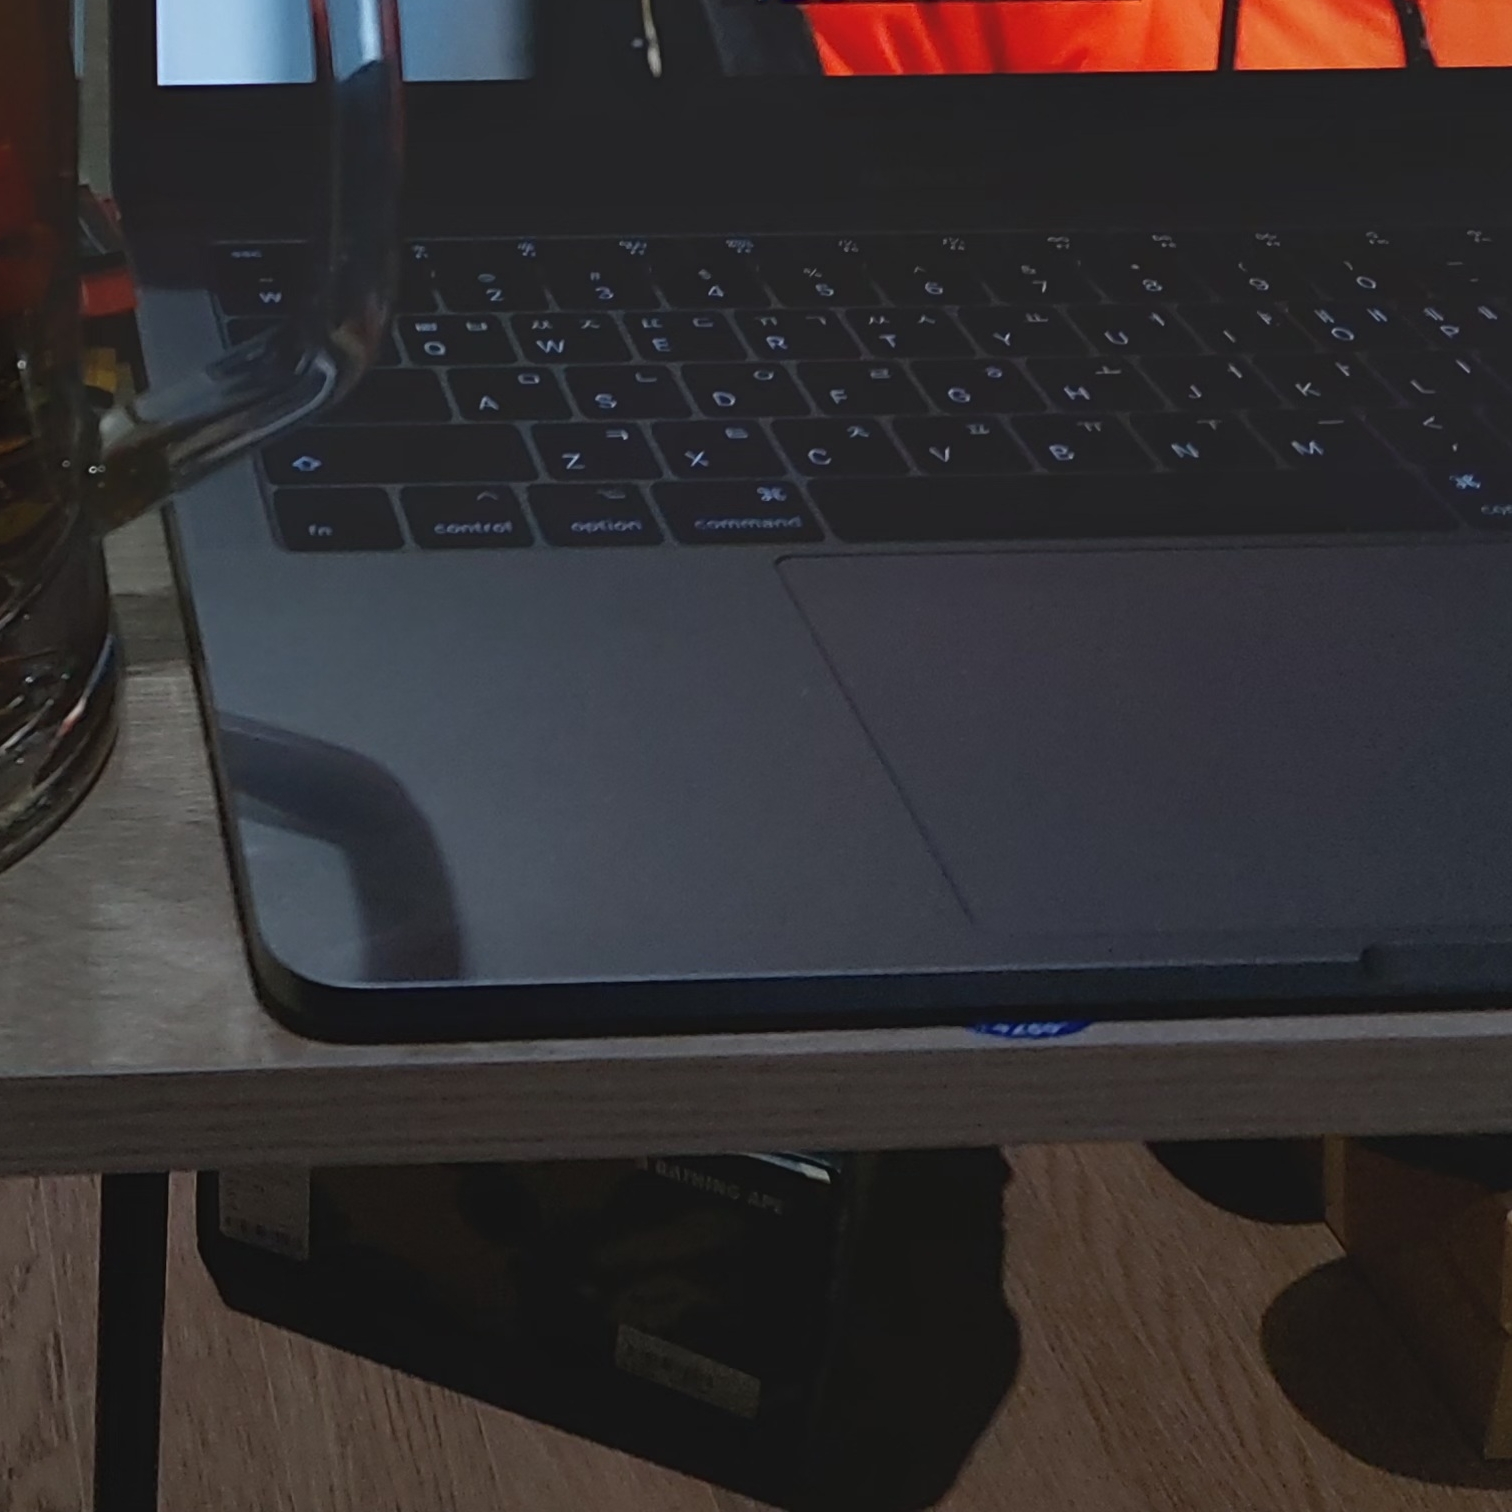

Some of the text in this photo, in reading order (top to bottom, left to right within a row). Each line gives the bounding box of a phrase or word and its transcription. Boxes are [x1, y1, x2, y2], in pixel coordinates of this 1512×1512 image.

[652, 338, 669, 351] E
[766, 336, 787, 349] R
[880, 334, 895, 347] T
[994, 333, 1010, 345] Y
[1105, 332, 1128, 344] U
[537, 340, 564, 353] W
[1064, 386, 1089, 400] H
[1189, 385, 1201, 398] J
[1296, 383, 1320, 396] K
[1411, 380, 1435, 393] L
[480, 396, 498, 409] A
[595, 394, 617, 408] S
[713, 392, 736, 406] D
[830, 390, 847, 404] F
[930, 447, 949, 462] V
[1049, 445, 1074, 460] B
[1171, 443, 1199, 458] N
[1292, 441, 1323, 455] M
[563, 453, 583, 469] Z
[685, 452, 707, 466] X
[808, 449, 831, 465] C
[434, 521, 512, 534] control
[571, 521, 642, 533] option
[695, 516, 801, 529] command
[309, 525, 332, 536] fn
